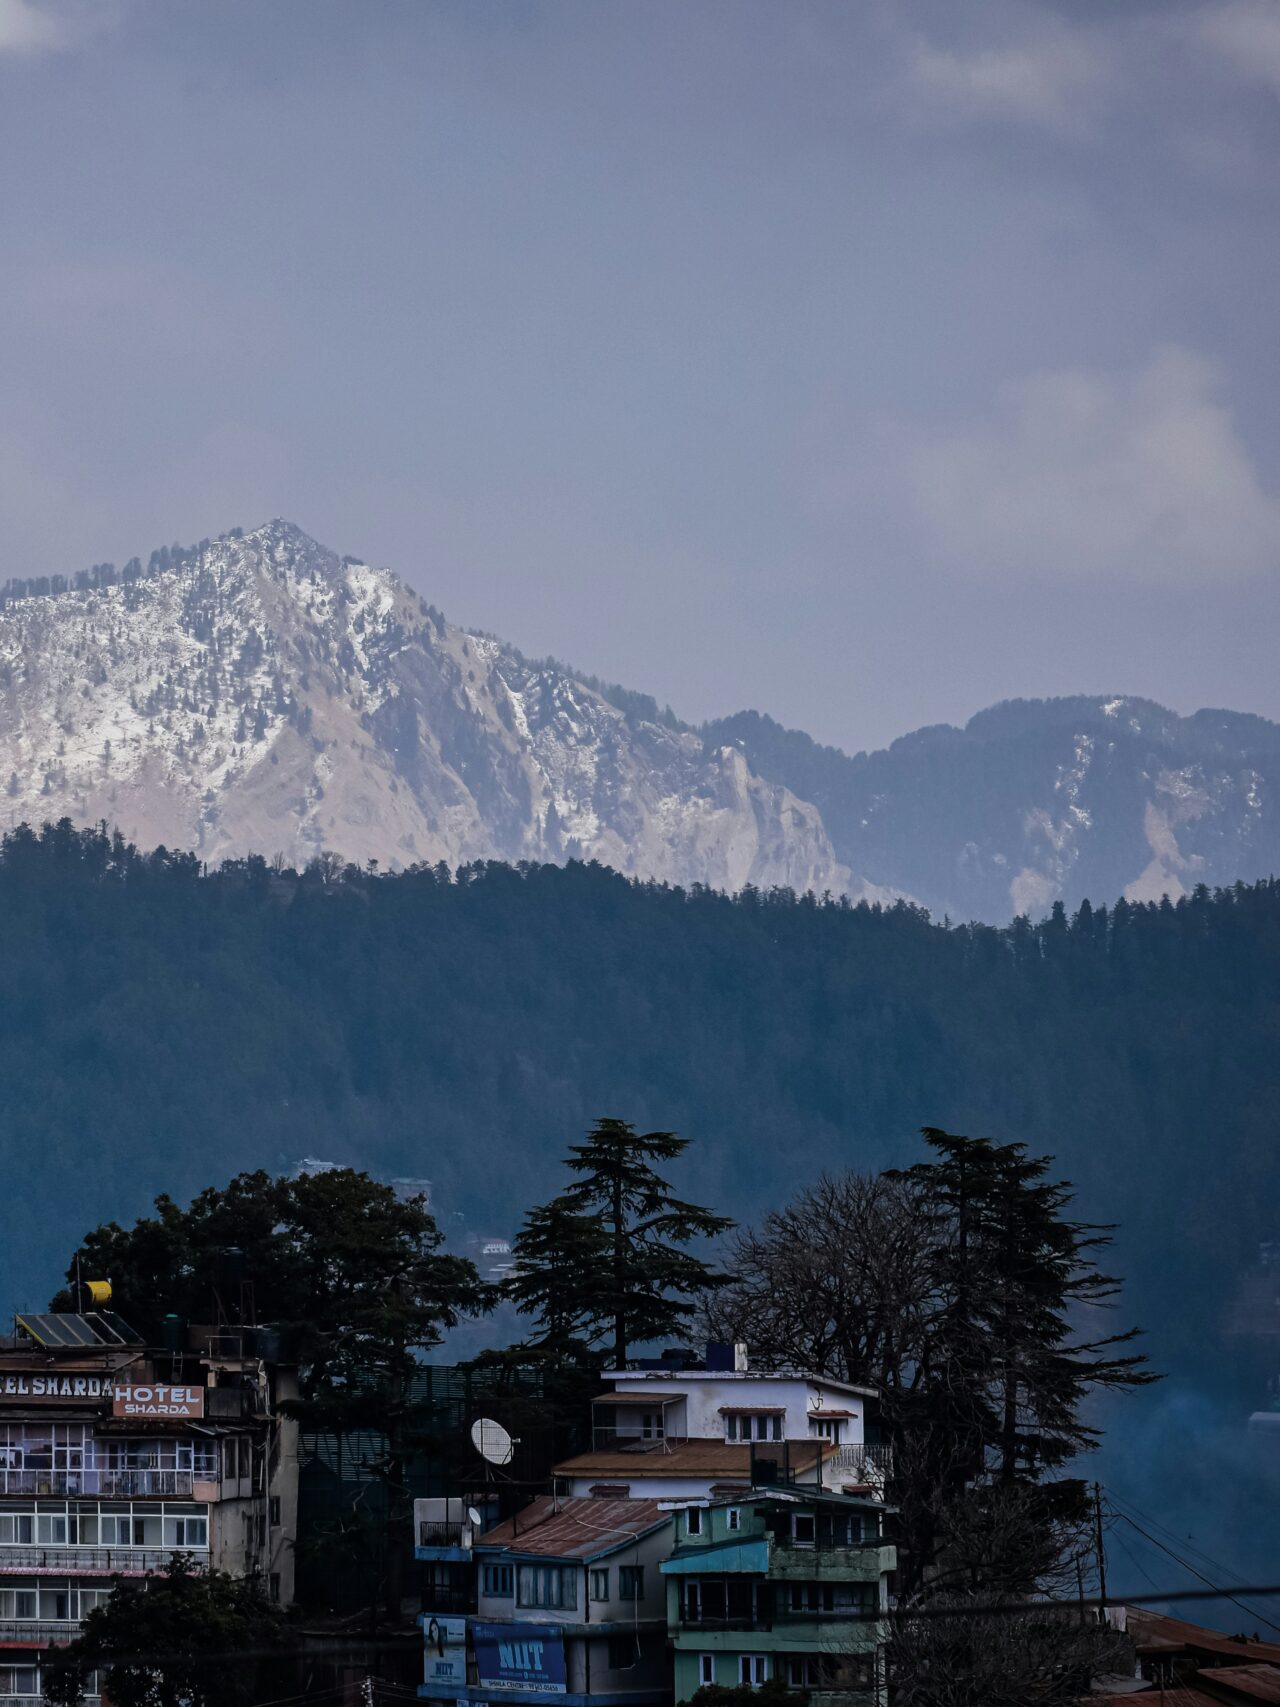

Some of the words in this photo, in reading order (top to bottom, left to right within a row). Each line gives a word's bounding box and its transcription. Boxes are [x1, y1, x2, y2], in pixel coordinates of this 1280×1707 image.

[32, 1376, 113, 1397] SHARDA
[115, 1387, 200, 1403] HOTEL
[125, 1404, 190, 1415] SHARDA
[497, 1639, 544, 1671] NIIT
[435, 1662, 453, 1676] NIIT
